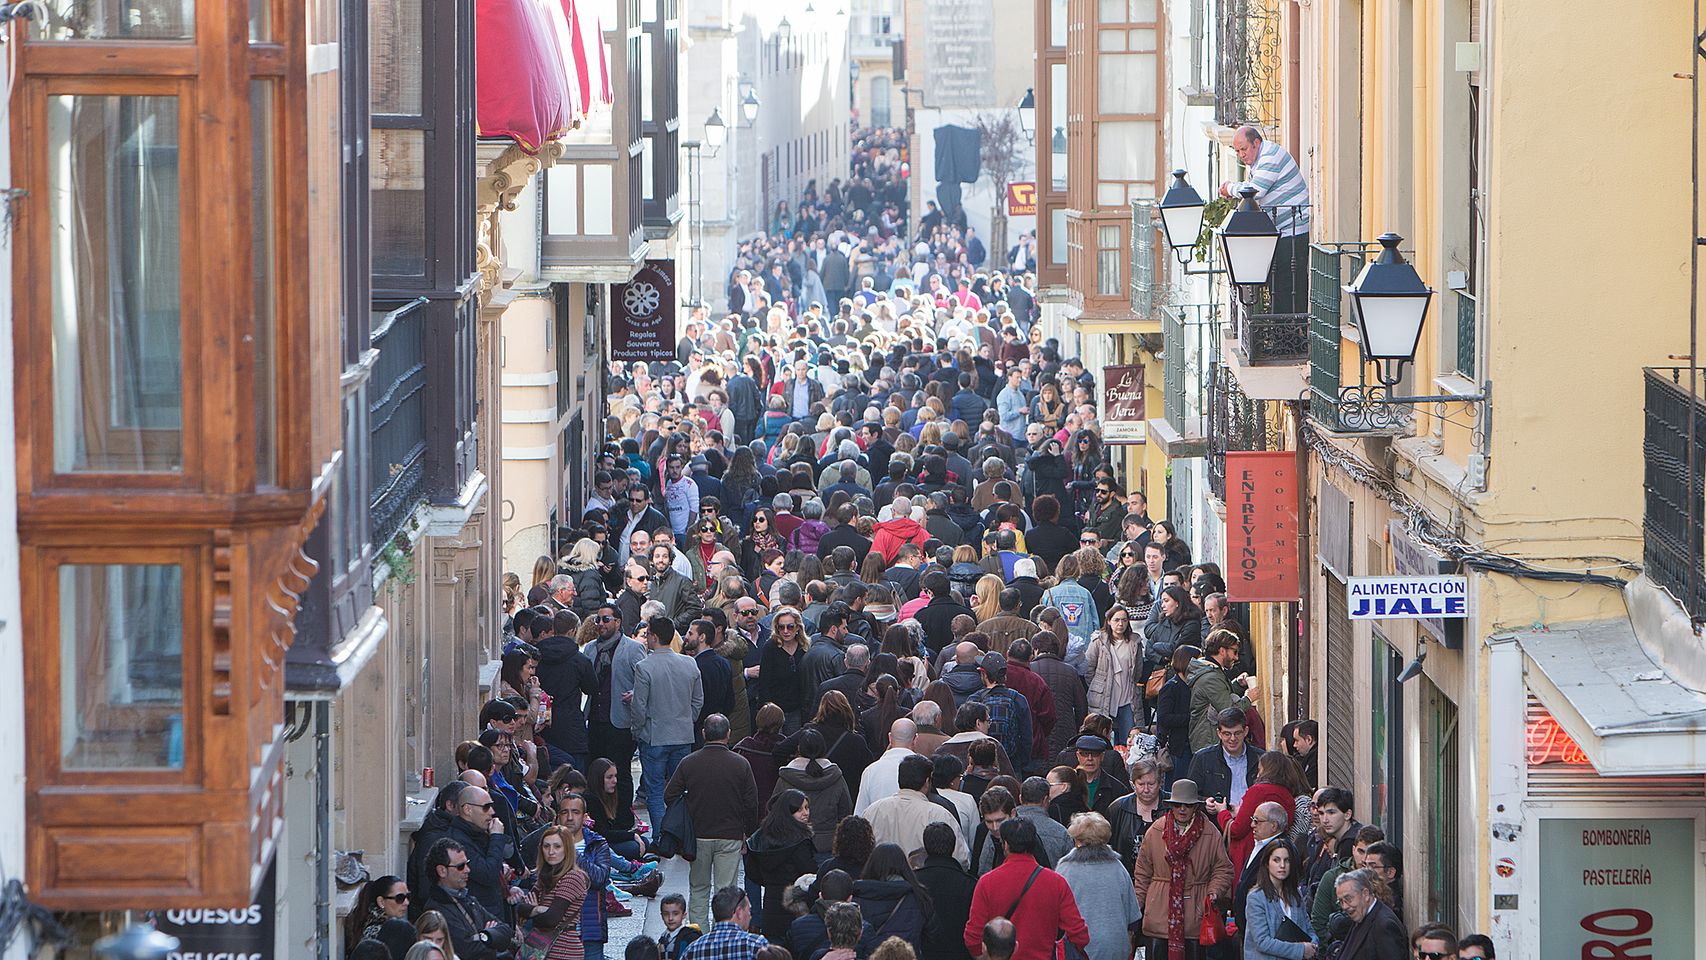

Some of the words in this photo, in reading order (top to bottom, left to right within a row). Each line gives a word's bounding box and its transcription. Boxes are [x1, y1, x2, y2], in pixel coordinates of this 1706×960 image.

[626, 340, 660, 348] Souvenirs
[629, 331, 657, 340] Regalos
[613, 349, 648, 357] Productos
[650, 349, 673, 358] típicos
[1117, 371, 1132, 388] La
[1106, 387, 1142, 401] Buena
[1241, 470, 1257, 580] ENTREVINOS
[1275, 470, 1285, 581] GOURMET
[1352, 580, 1465, 595] ALIMENTACIÓN
[1352, 597, 1465, 616] JIALE
[1582, 825, 1651, 846] BOMBONERÍA
[1583, 864, 1652, 886] PASTELERÍA
[166, 904, 262, 926] QUESOS
